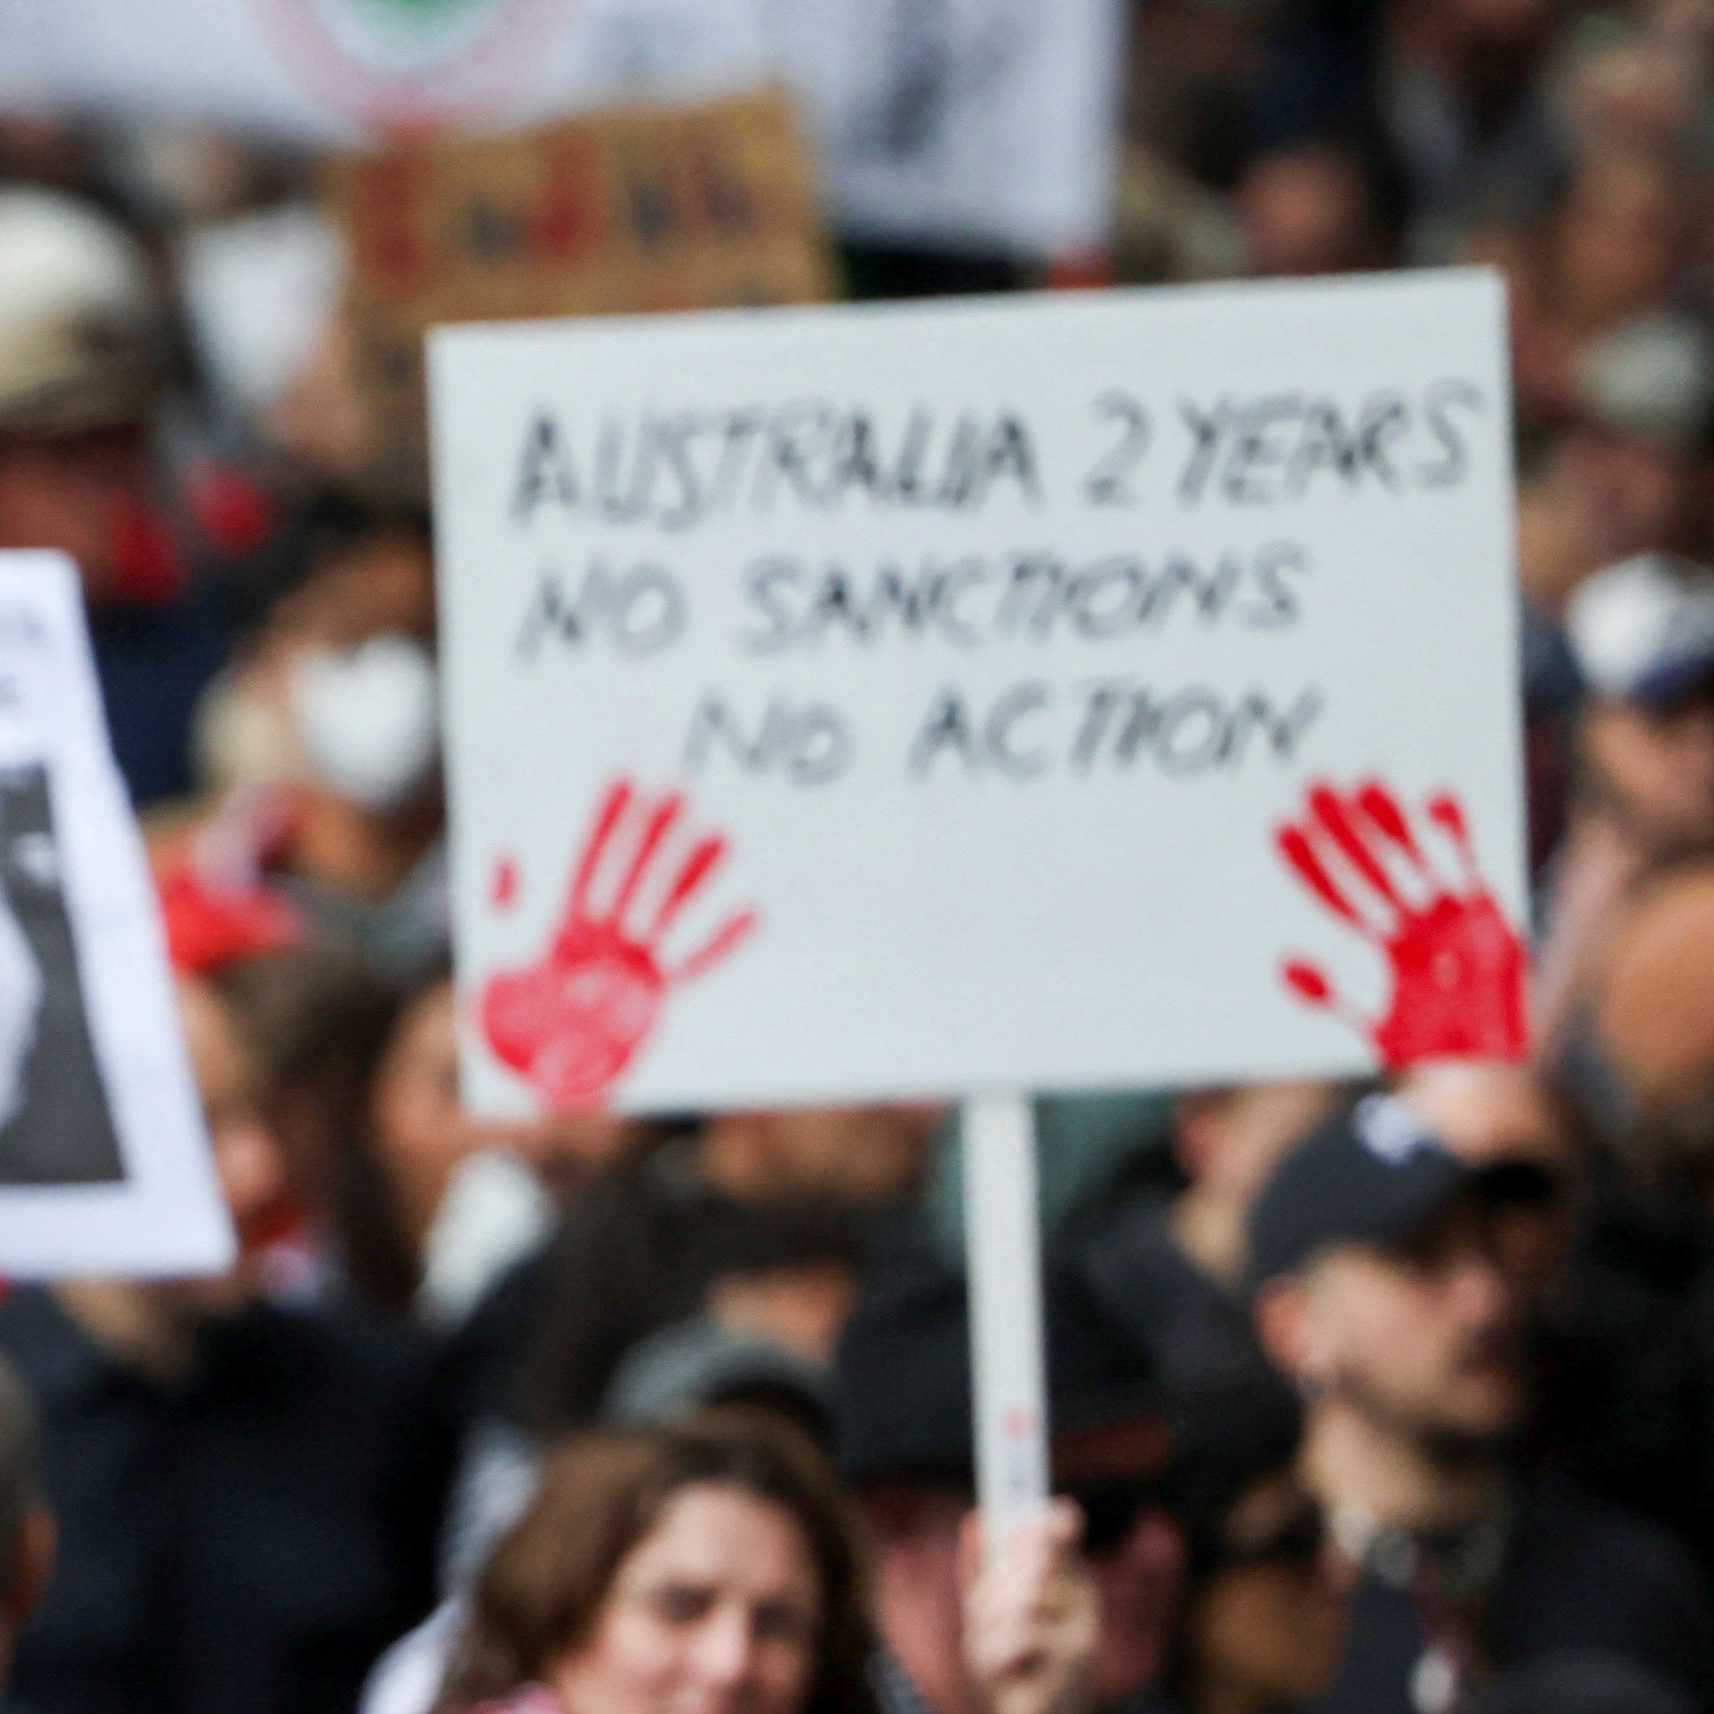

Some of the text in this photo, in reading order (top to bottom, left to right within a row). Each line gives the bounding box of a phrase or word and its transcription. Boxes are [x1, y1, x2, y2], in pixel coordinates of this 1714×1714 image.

[508, 378, 1484, 530] AUSTRALIA 2 YEARS
[518, 540, 1310, 660] NO SANCTIONS
[680, 680, 1328, 786] NO ACTION
